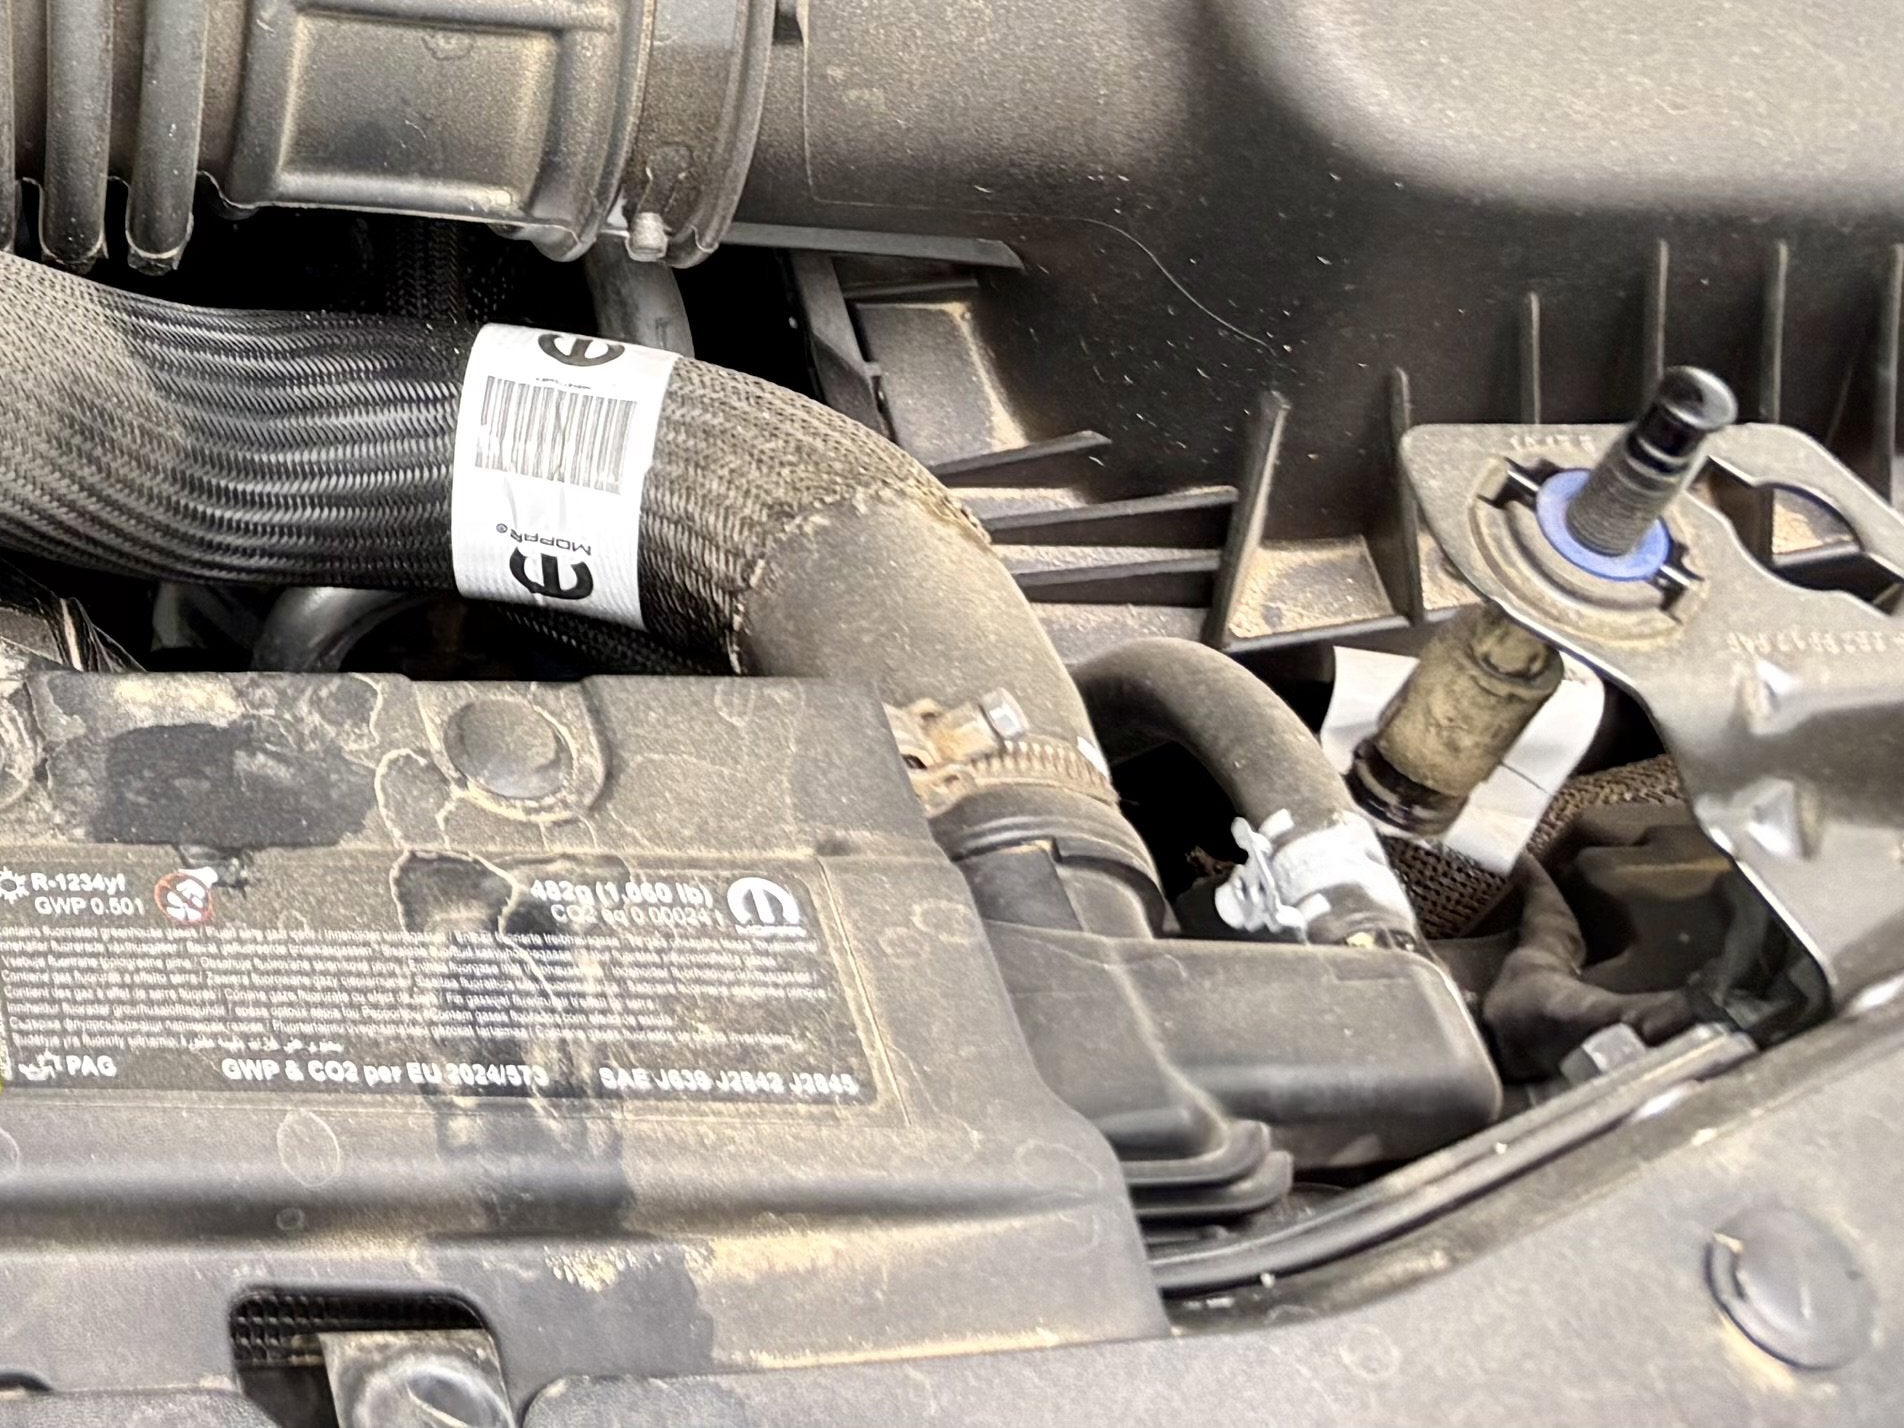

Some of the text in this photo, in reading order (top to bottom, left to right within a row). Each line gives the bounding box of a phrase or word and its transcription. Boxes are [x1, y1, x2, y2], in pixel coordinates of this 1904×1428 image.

[34, 896, 145, 916] GWP 0.501
[530, 879, 596, 907] 482g
[675, 881, 714, 909] lb)
[550, 903, 597, 924] CO2
[65, 1054, 118, 1078] PAG
[221, 1058, 281, 1081] GWP
[284, 1059, 305, 1082] &
[307, 1059, 360, 1083] CO2
[363, 1063, 403, 1087] per
[405, 1062, 443, 1084] EU
[598, 1066, 653, 1091] SAE
